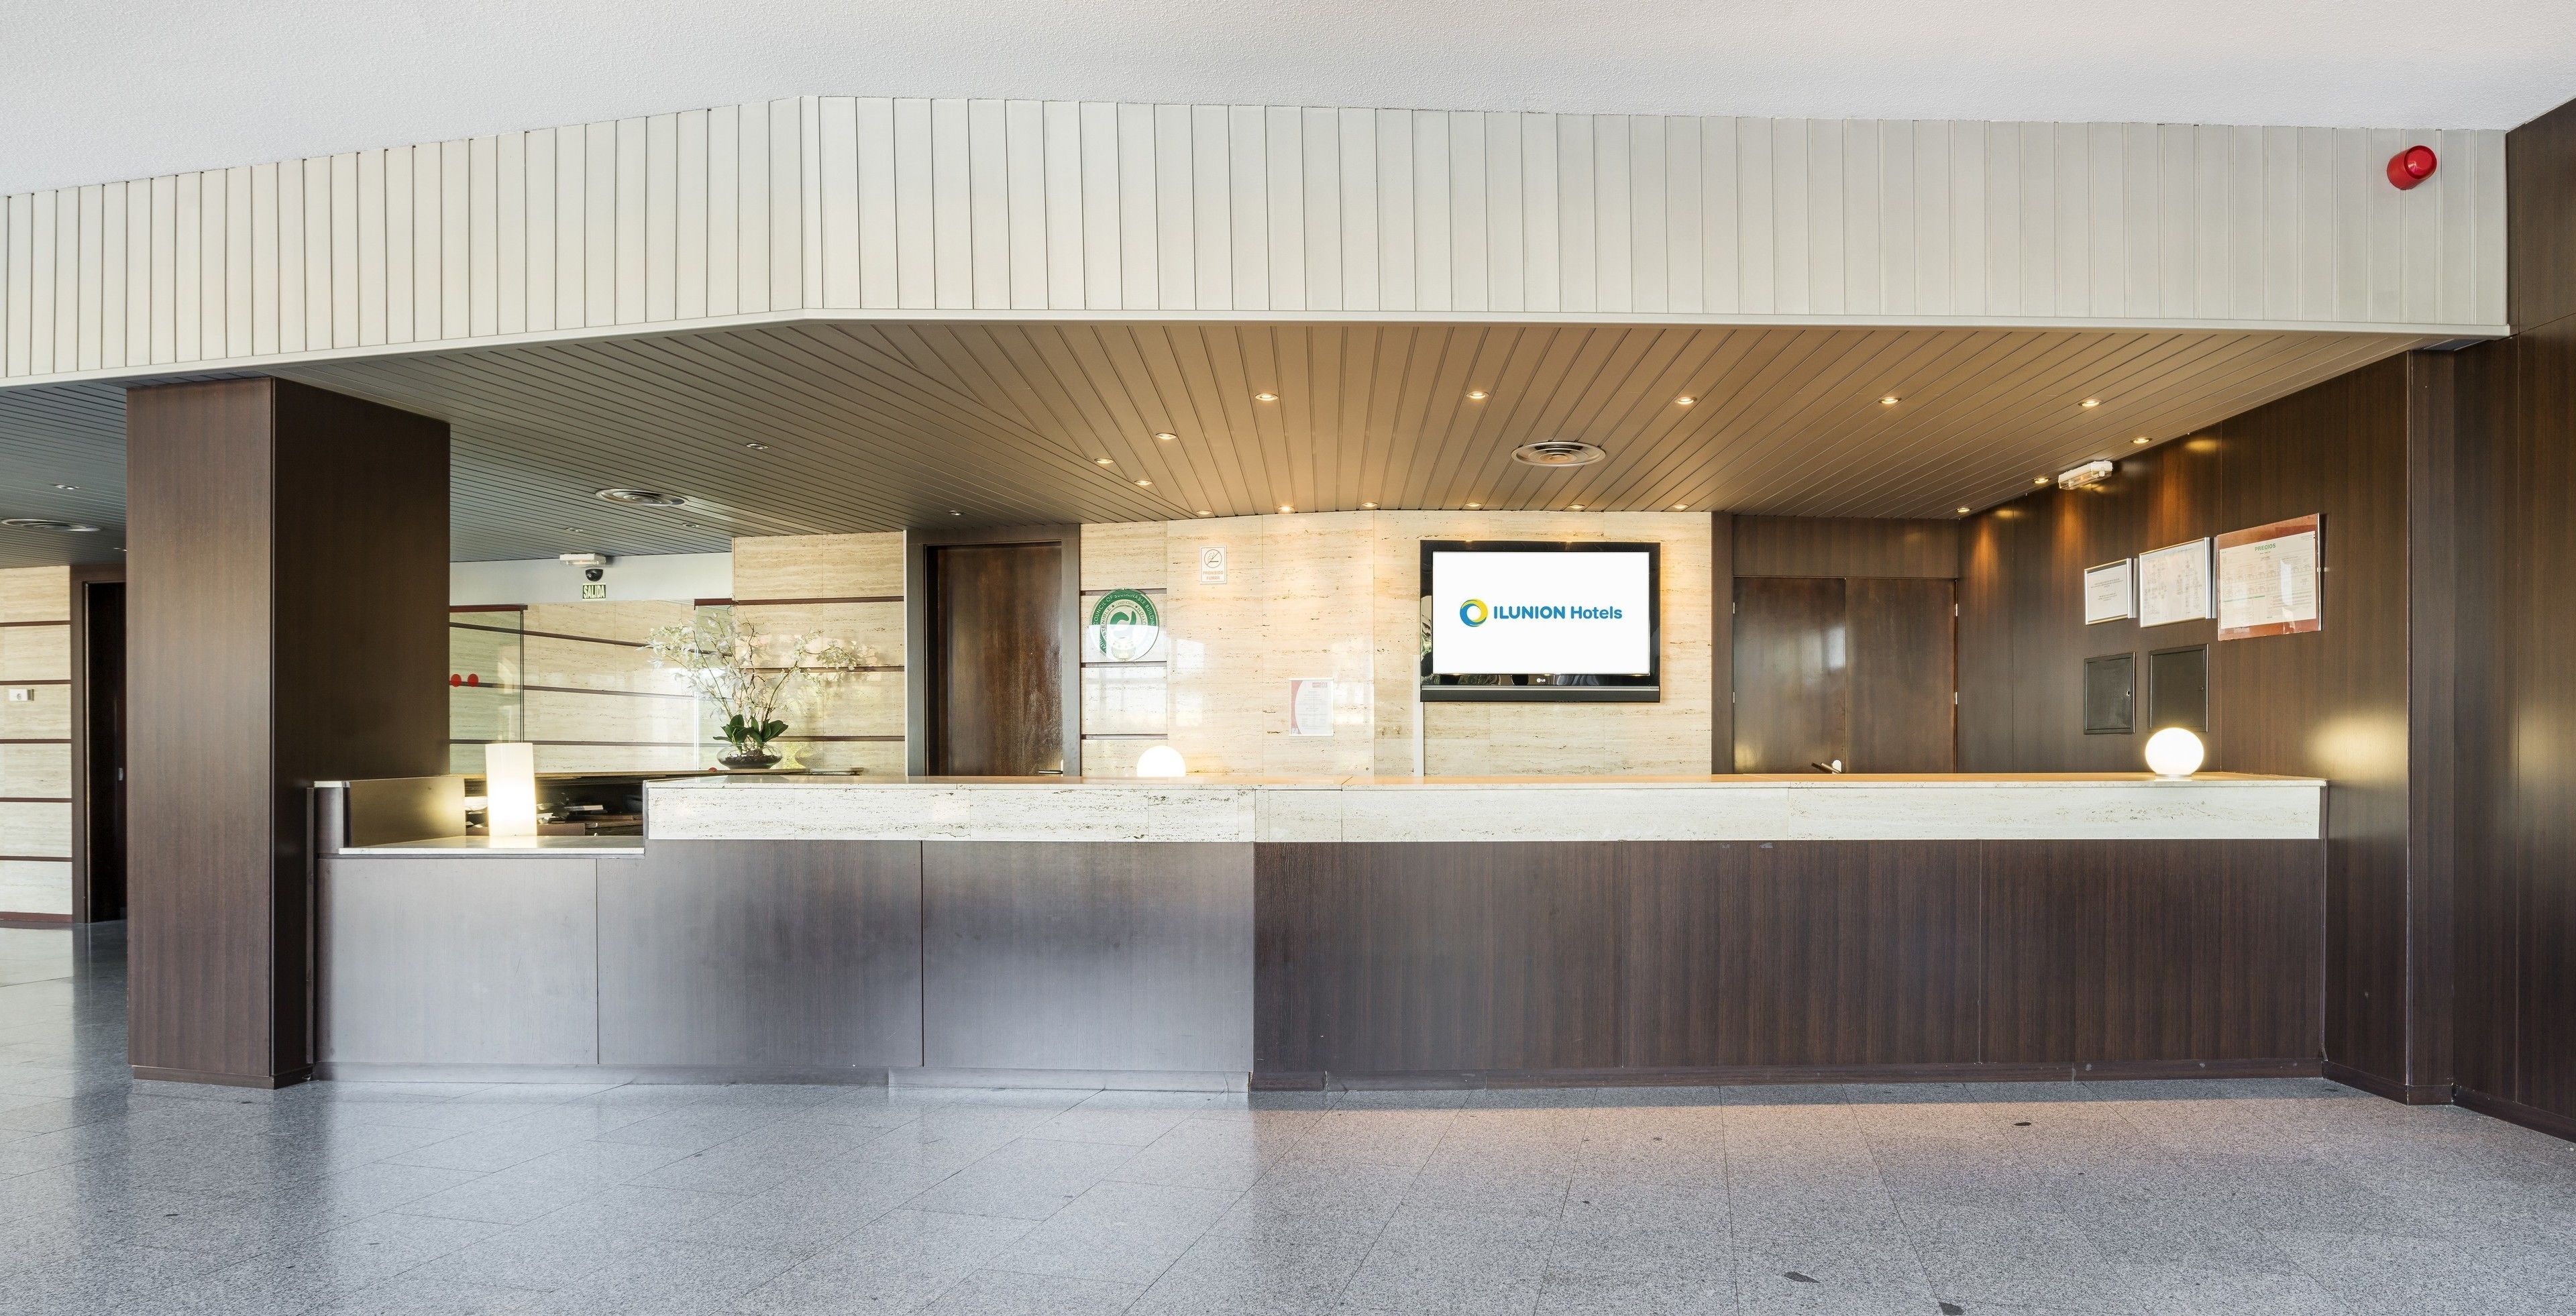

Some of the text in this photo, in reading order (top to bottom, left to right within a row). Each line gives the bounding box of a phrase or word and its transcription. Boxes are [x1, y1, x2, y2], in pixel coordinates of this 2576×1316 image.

[2254, 543, 2276, 551] PRECIOS
[584, 585, 605, 598] SALIDA
[1093, 602, 1106, 625] COUNCIL
[1145, 604, 1155, 625] BUILDIN
[1493, 606, 1623, 619] ILUNION Hotels
